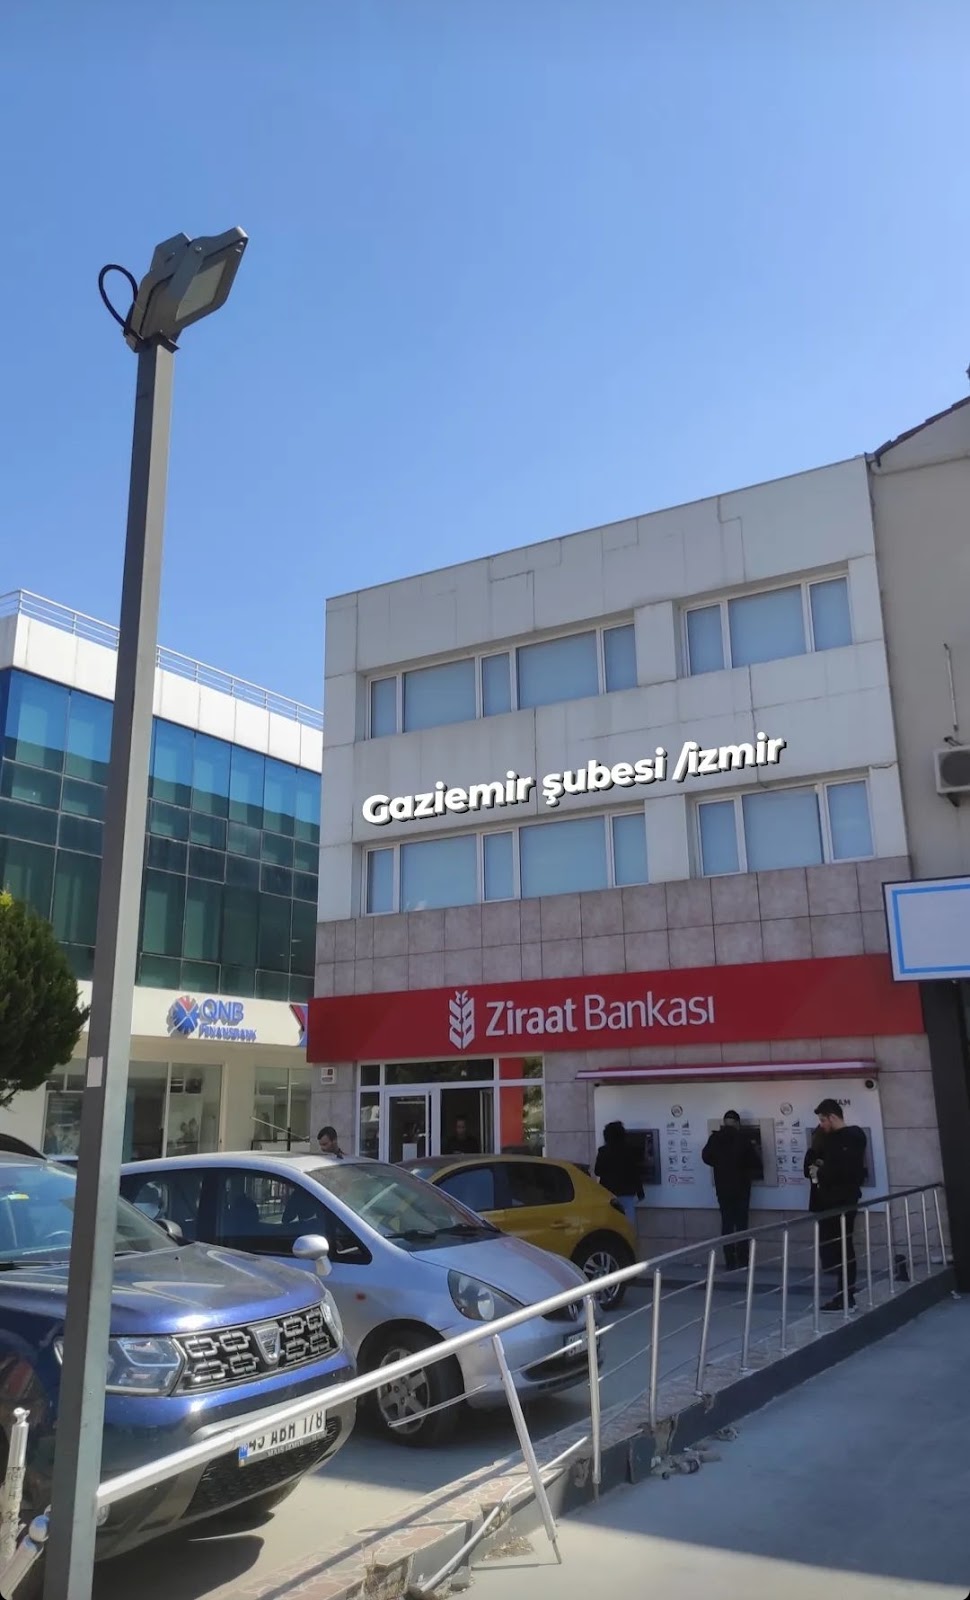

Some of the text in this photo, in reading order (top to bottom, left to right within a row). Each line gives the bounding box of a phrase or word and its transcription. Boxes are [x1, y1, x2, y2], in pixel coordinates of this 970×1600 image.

[202, 998, 244, 1023] QNB
[485, 990, 715, 1037] Ziraat Bankası
